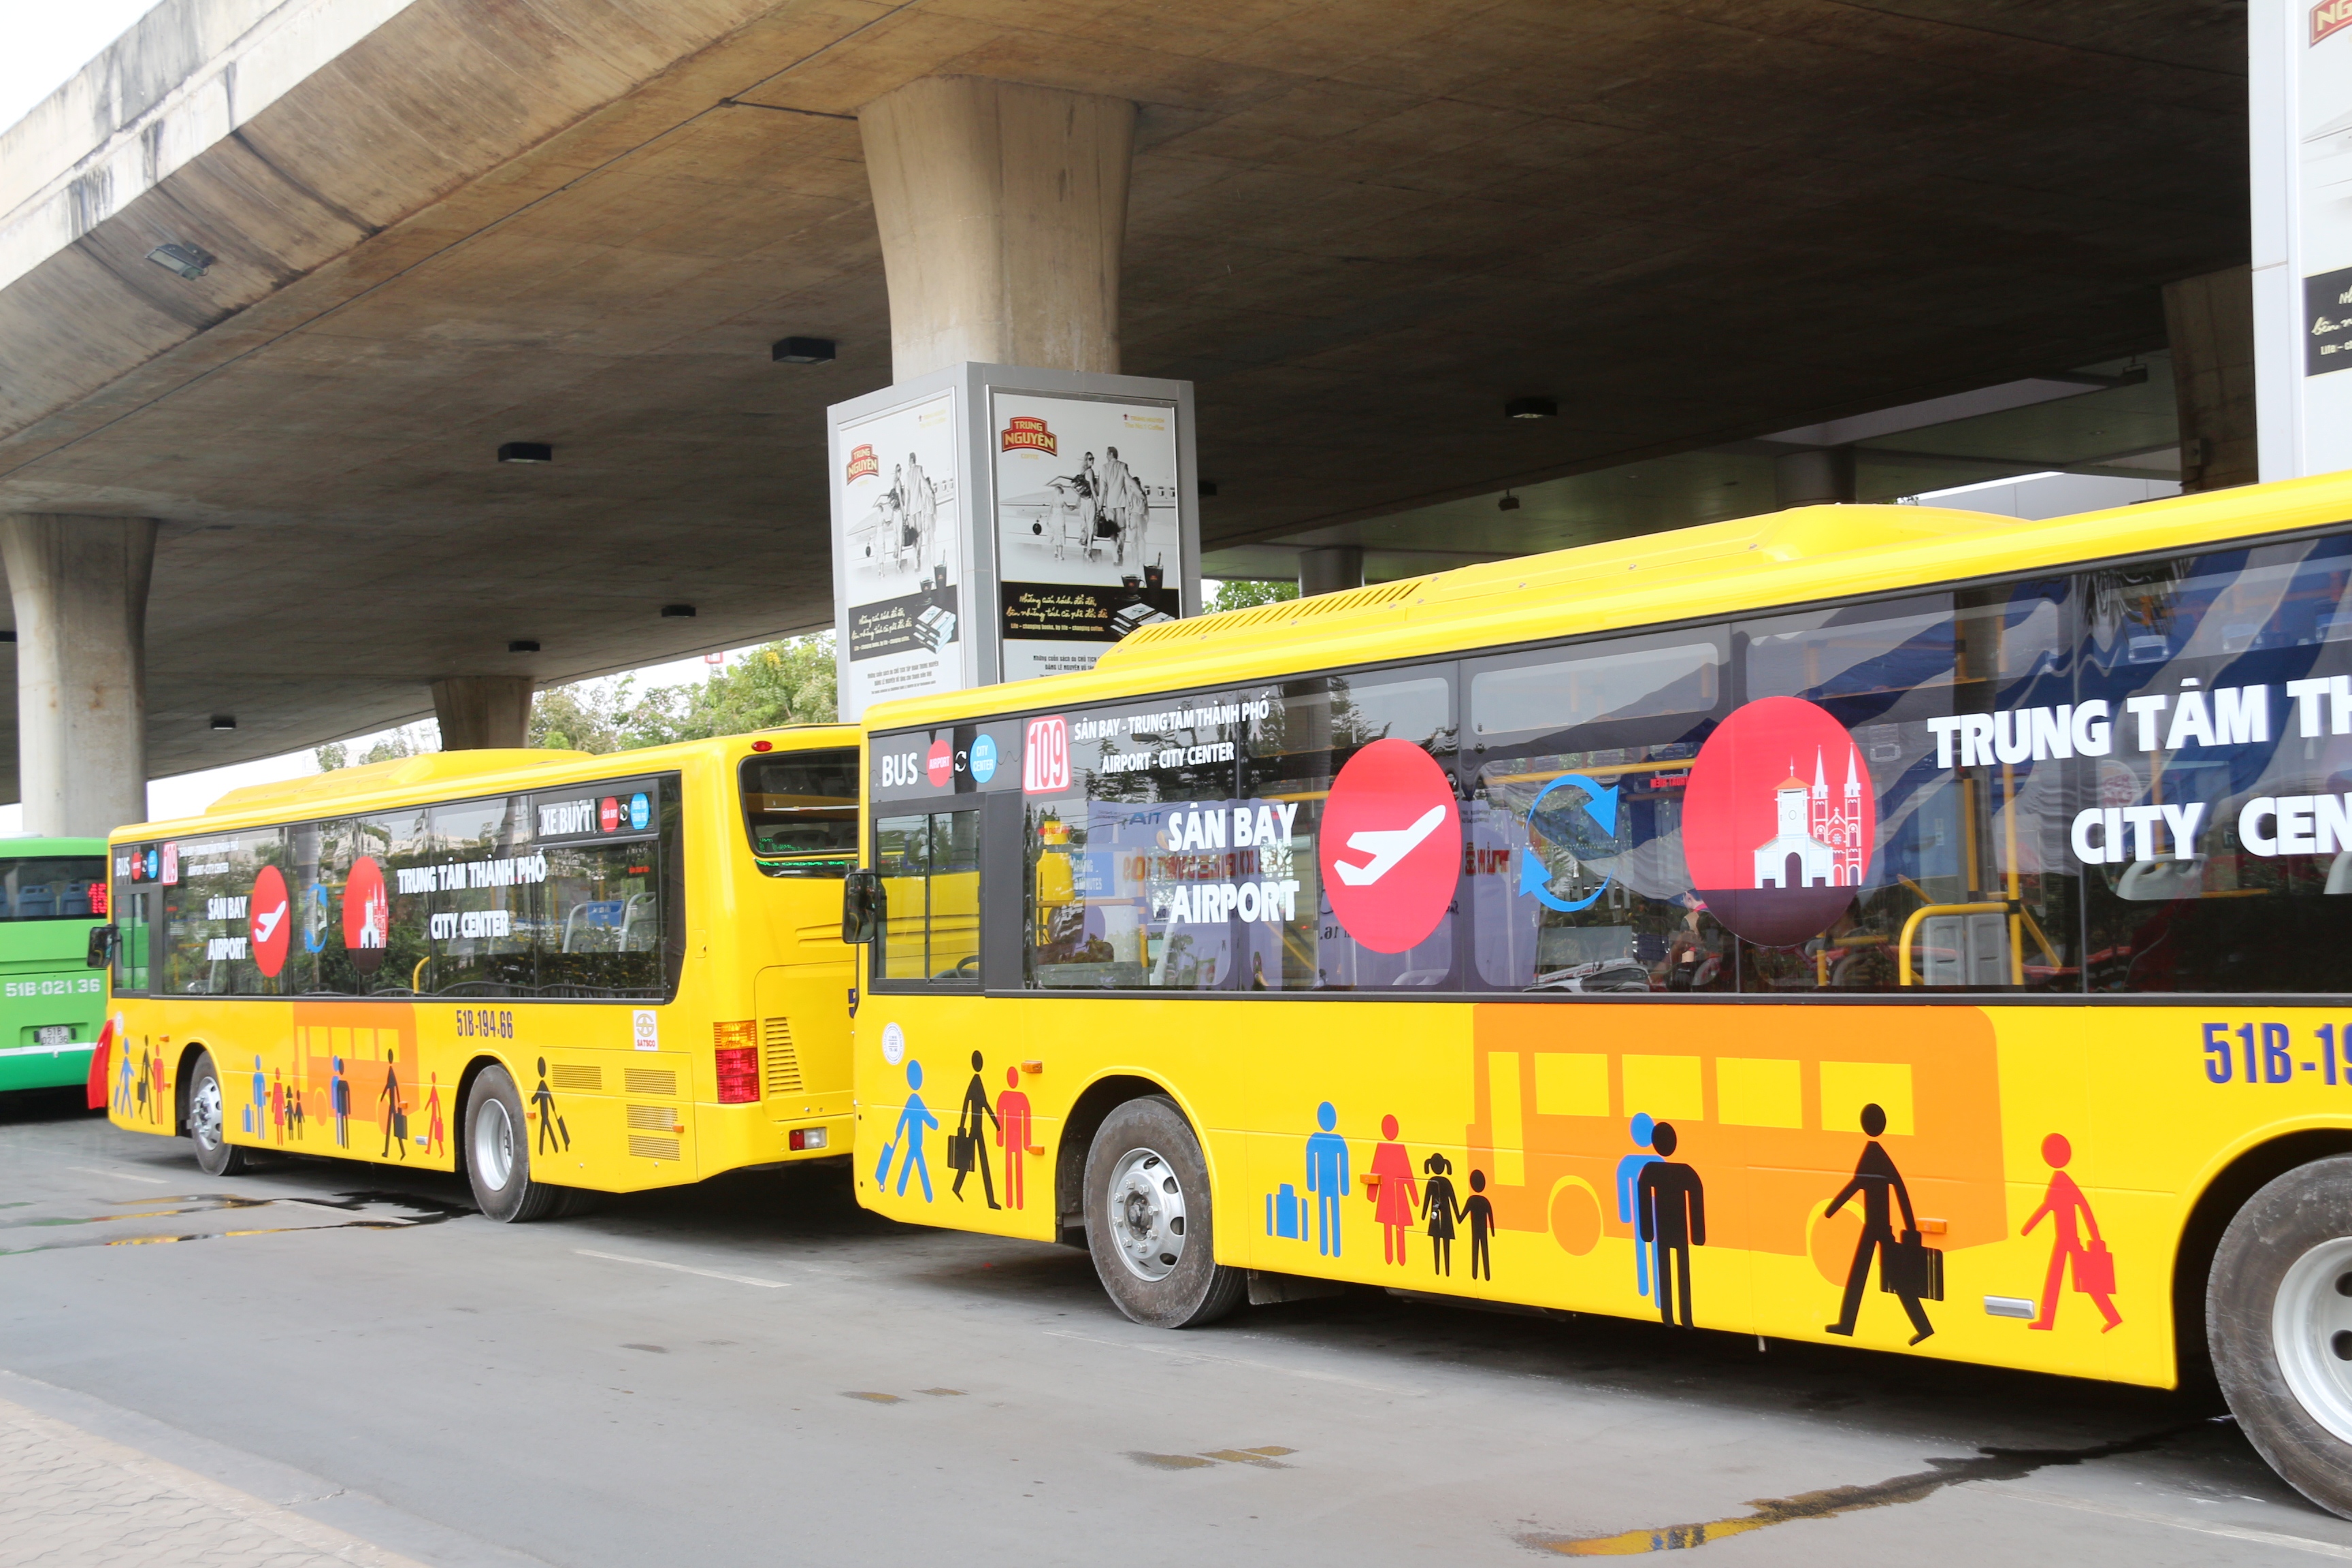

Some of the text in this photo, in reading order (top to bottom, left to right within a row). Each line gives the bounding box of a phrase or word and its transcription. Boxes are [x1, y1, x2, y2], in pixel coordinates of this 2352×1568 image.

[1014, 421, 1043, 431] TRUNG
[853, 448, 870, 461] TRUNG
[1004, 432, 1054, 450] NGUYÊN
[848, 457, 878, 478] NGUYÊN
[1075, 717, 1097, 740] SÂN
[1098, 719, 1121, 738] BAY
[1128, 713, 1167, 734] TRUNG
[1168, 706, 1194, 730] TÂM
[1196, 700, 1239, 727] THÀNH
[1242, 691, 1270, 722] PHỐ
[1927, 699, 2111, 769] TRUNG
[2126, 677, 2269, 751] TÂM
[929, 756, 950, 770] AIRPORT
[973, 759, 994, 772] CENTER
[977, 745, 988, 757] CITY
[1030, 721, 1064, 787] 109
[1102, 752, 1152, 774] AIRPORT
[1158, 748, 1187, 769] CITY
[1187, 742, 1235, 766] CENTER
[882, 752, 918, 787] BUS
[542, 800, 591, 836] XE BUÝT
[1168, 802, 1298, 851] SÂN BAY
[2070, 791, 2352, 865] CITY CEN
[116, 857, 130, 877] BUS
[397, 847, 546, 894] TRUNG TÂM THÀNH PHỐ
[208, 894, 247, 920] SÂN BAY
[1169, 880, 1300, 924] AIRPORT
[431, 910, 509, 939] CITY CENTER
[208, 937, 247, 960] AIRPORT
[457, 1010, 513, 1039] 51B-194.66
[637, 1039, 656, 1047] SATSCO
